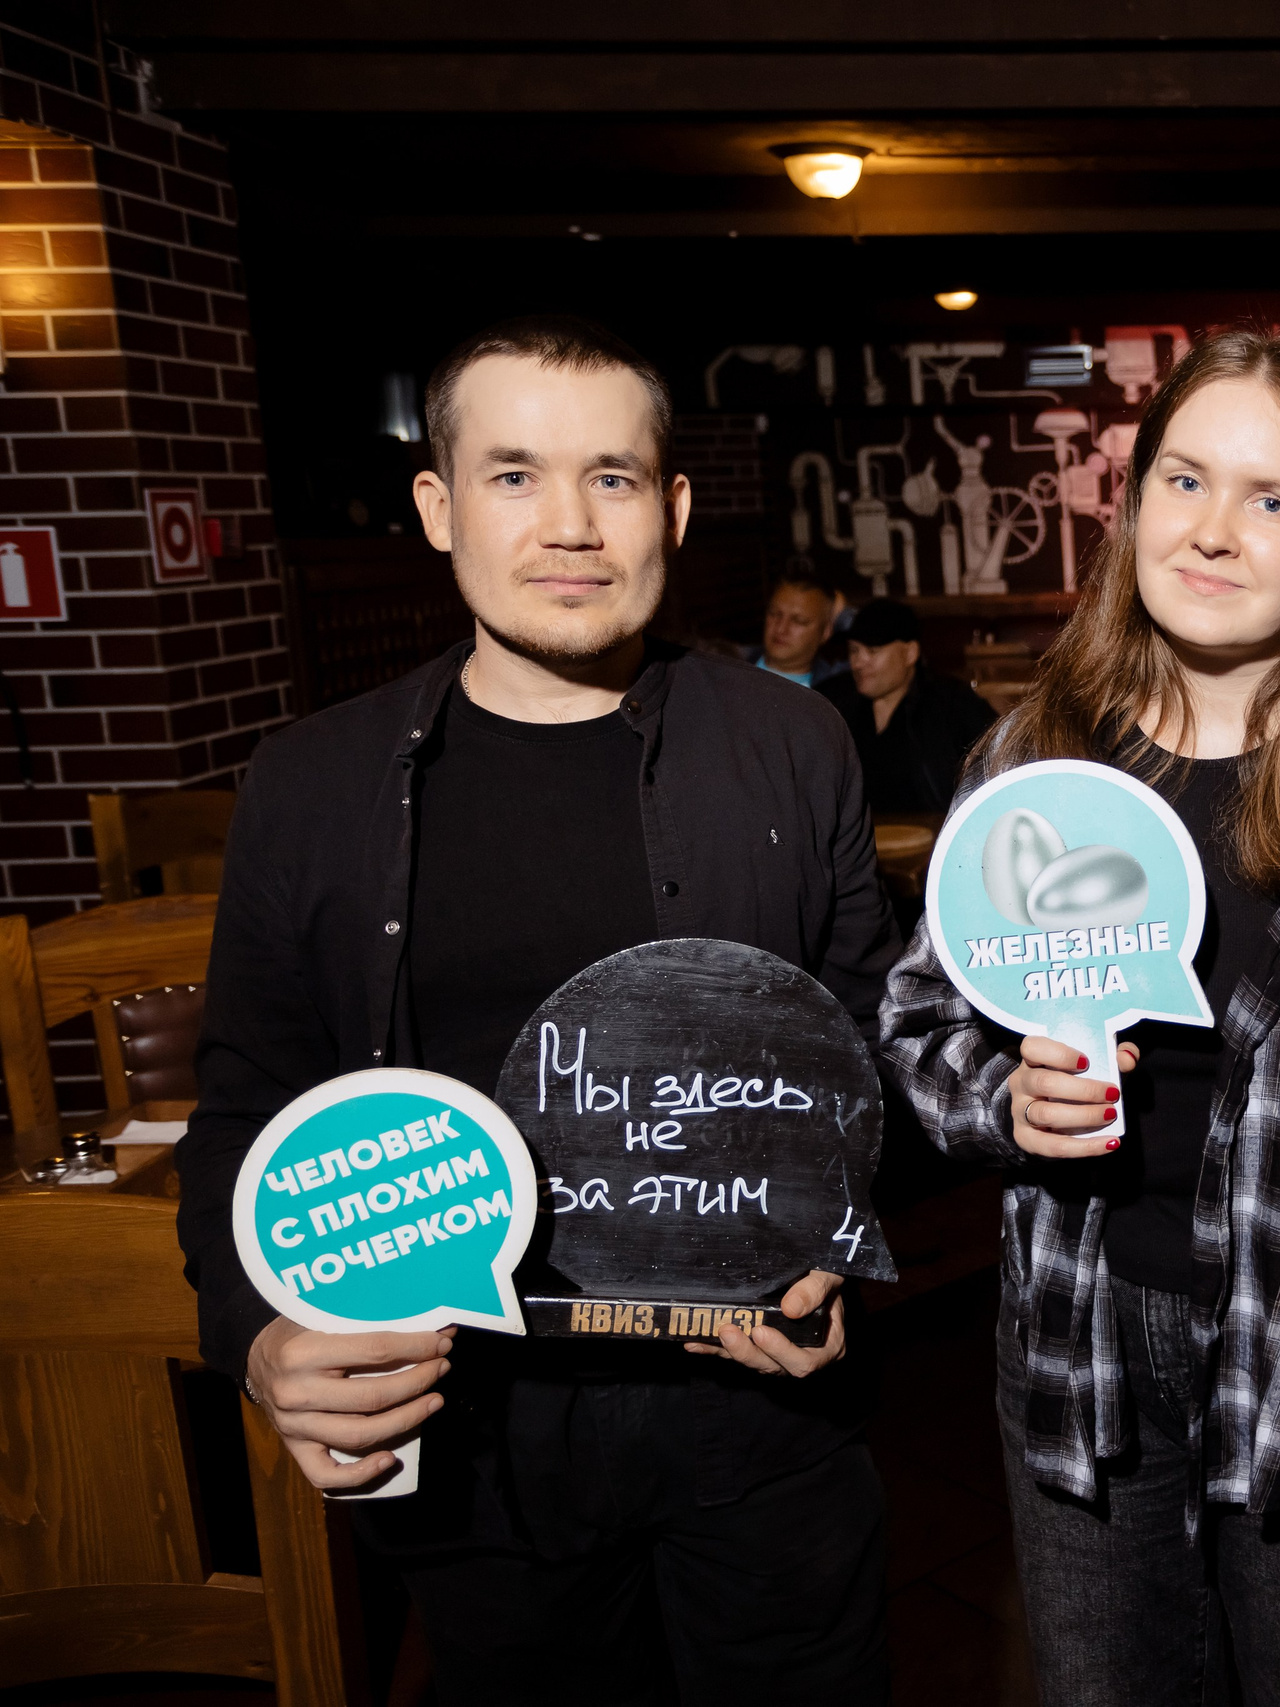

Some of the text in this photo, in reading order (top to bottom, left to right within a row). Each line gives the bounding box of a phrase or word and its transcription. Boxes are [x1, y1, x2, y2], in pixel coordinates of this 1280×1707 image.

[964, 921, 1171, 969] ЖЕЛЕЗНЫЕ
[1023, 961, 1130, 1001] ЯЙЦА
[539, 1021, 631, 1114] Мы
[650, 1073, 814, 1115] здесь
[264, 1109, 461, 1197] ЧЕЛОВЕК
[626, 1120, 688, 1151] не
[271, 1148, 490, 1248] С ПЛОХИМ
[542, 1175, 769, 1214] за этим
[280, 1189, 512, 1296] ПОЧЕРКОМ
[832, 1206, 865, 1262] 4
[570, 1302, 660, 1338] КВИЗ,
